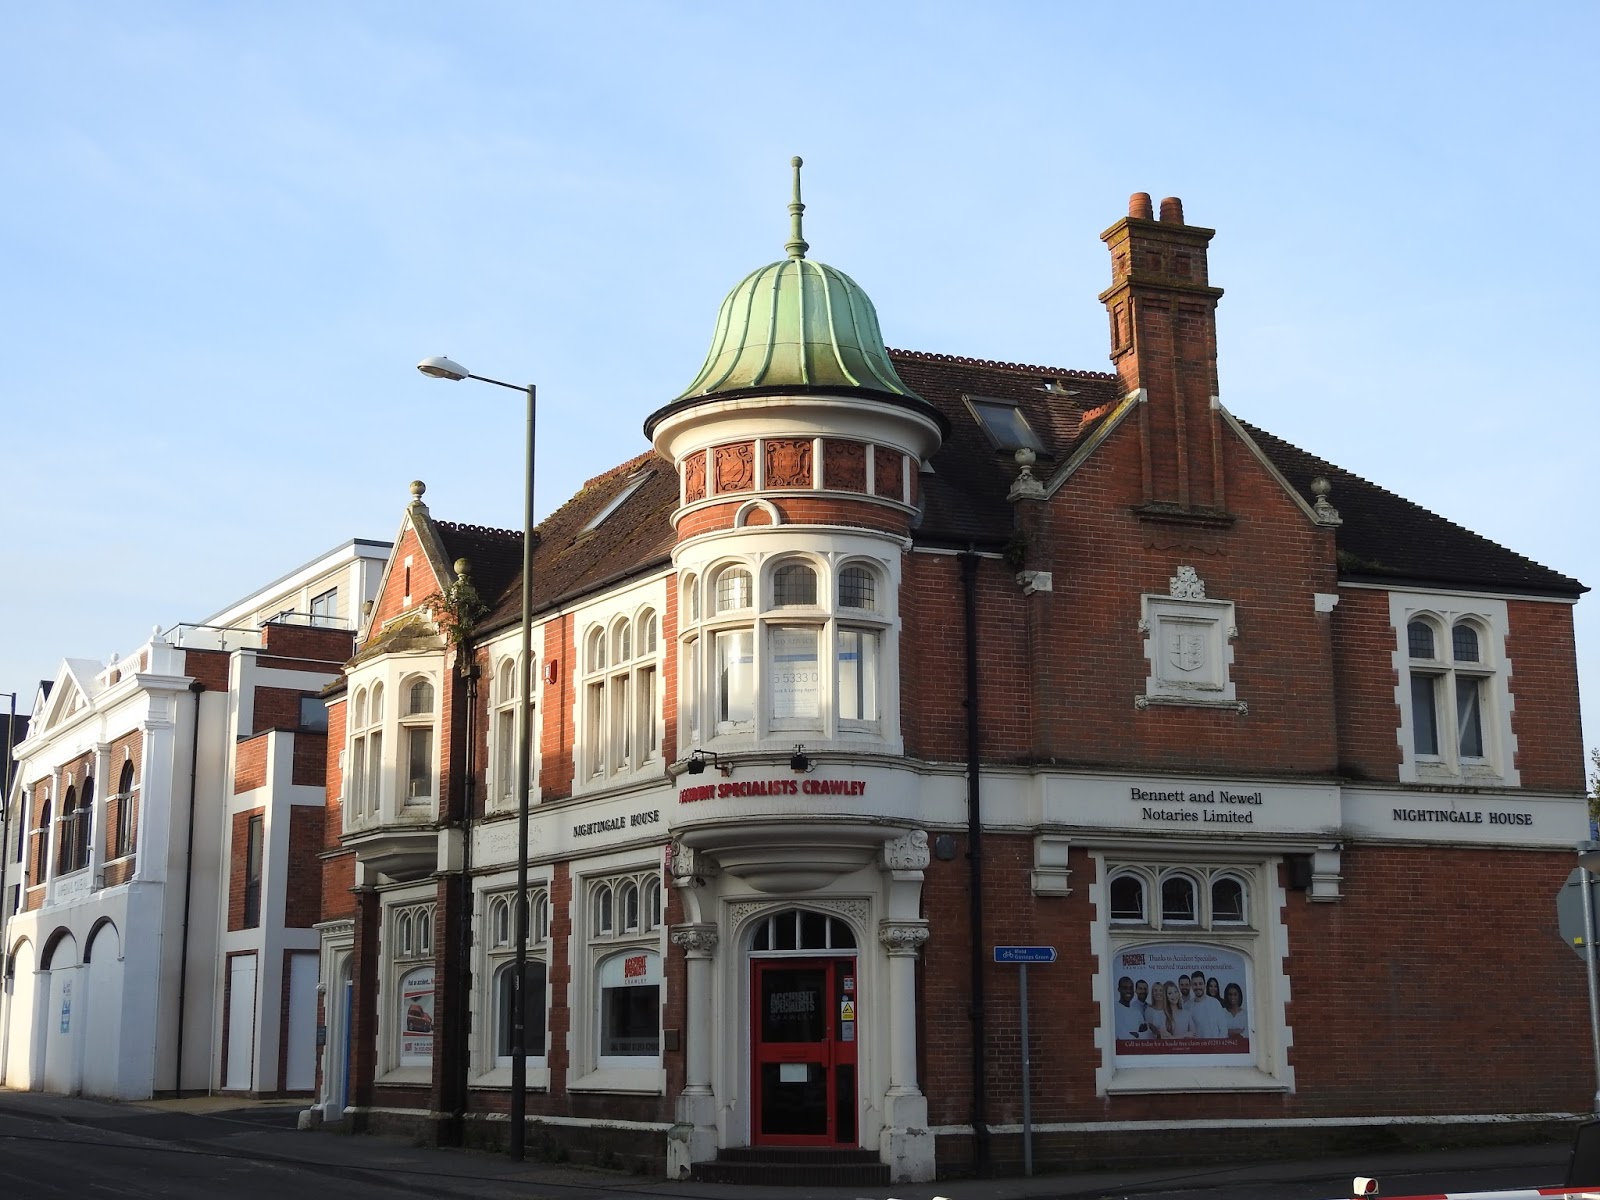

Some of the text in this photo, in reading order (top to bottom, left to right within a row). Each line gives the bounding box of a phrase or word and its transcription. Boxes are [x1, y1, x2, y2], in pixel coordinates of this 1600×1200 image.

[783, 672, 808, 683] 5333
[717, 780, 798, 798] SPECIALISTS
[802, 779, 866, 796] CRAWLEY
[1130, 787, 1263, 805] Bennett and Newell
[1142, 807, 1253, 823] Notaries Limited
[1392, 809, 1533, 826] NIGHTINGALE HOUSE
[573, 809, 660, 838] NIGHTINGALE HOUSE
[1149, 954, 1166, 962] Thanks
[1173, 954, 1193, 962] Accident
[1194, 954, 1218, 963] Specialists
[770, 991, 817, 1002] ACCIDENT
[770, 1000, 815, 1014] SPECIALISTS
[1141, 1040, 1153, 1048] today
